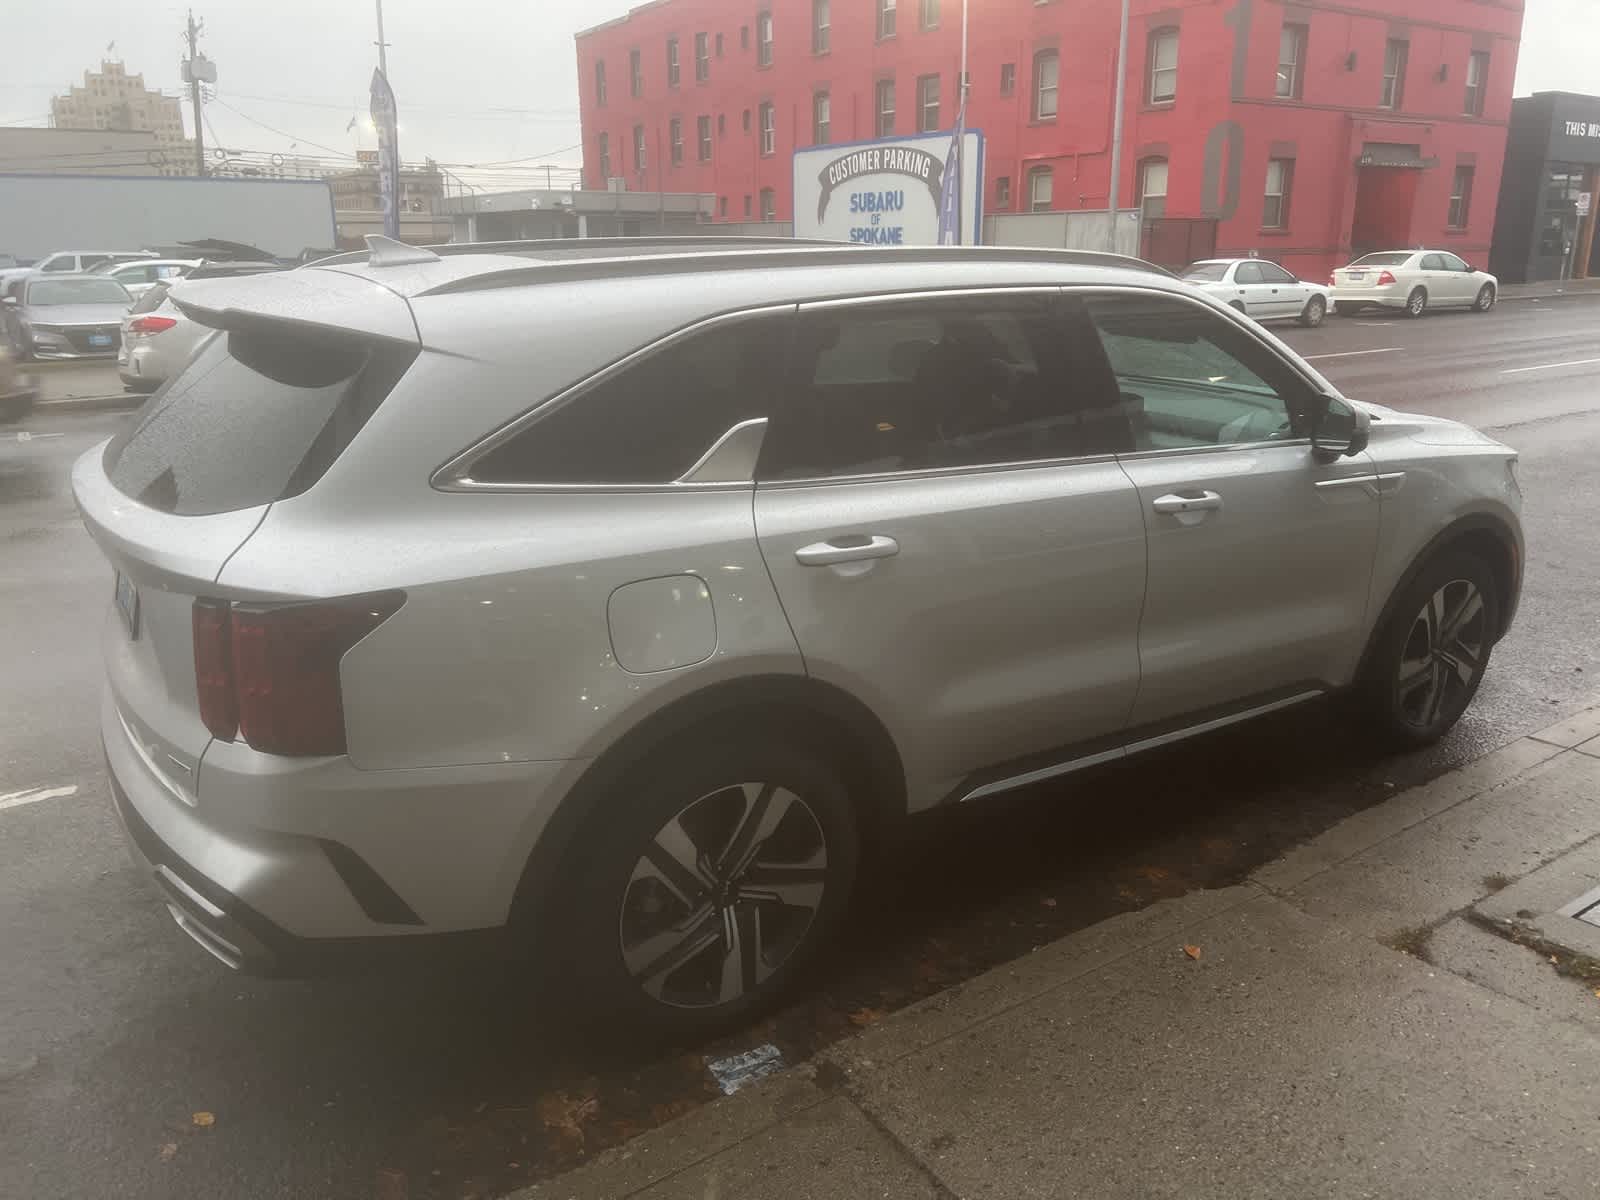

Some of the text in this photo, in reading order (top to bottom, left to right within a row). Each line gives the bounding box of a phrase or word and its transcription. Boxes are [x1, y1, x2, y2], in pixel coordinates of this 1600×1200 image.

[1565, 121, 1586, 137] THIS
[829, 148, 931, 185] CUSTOMER PARKING
[849, 190, 904, 213] SUBARU
[871, 213, 881, 225] OF
[849, 226, 903, 246] SPOKANE
